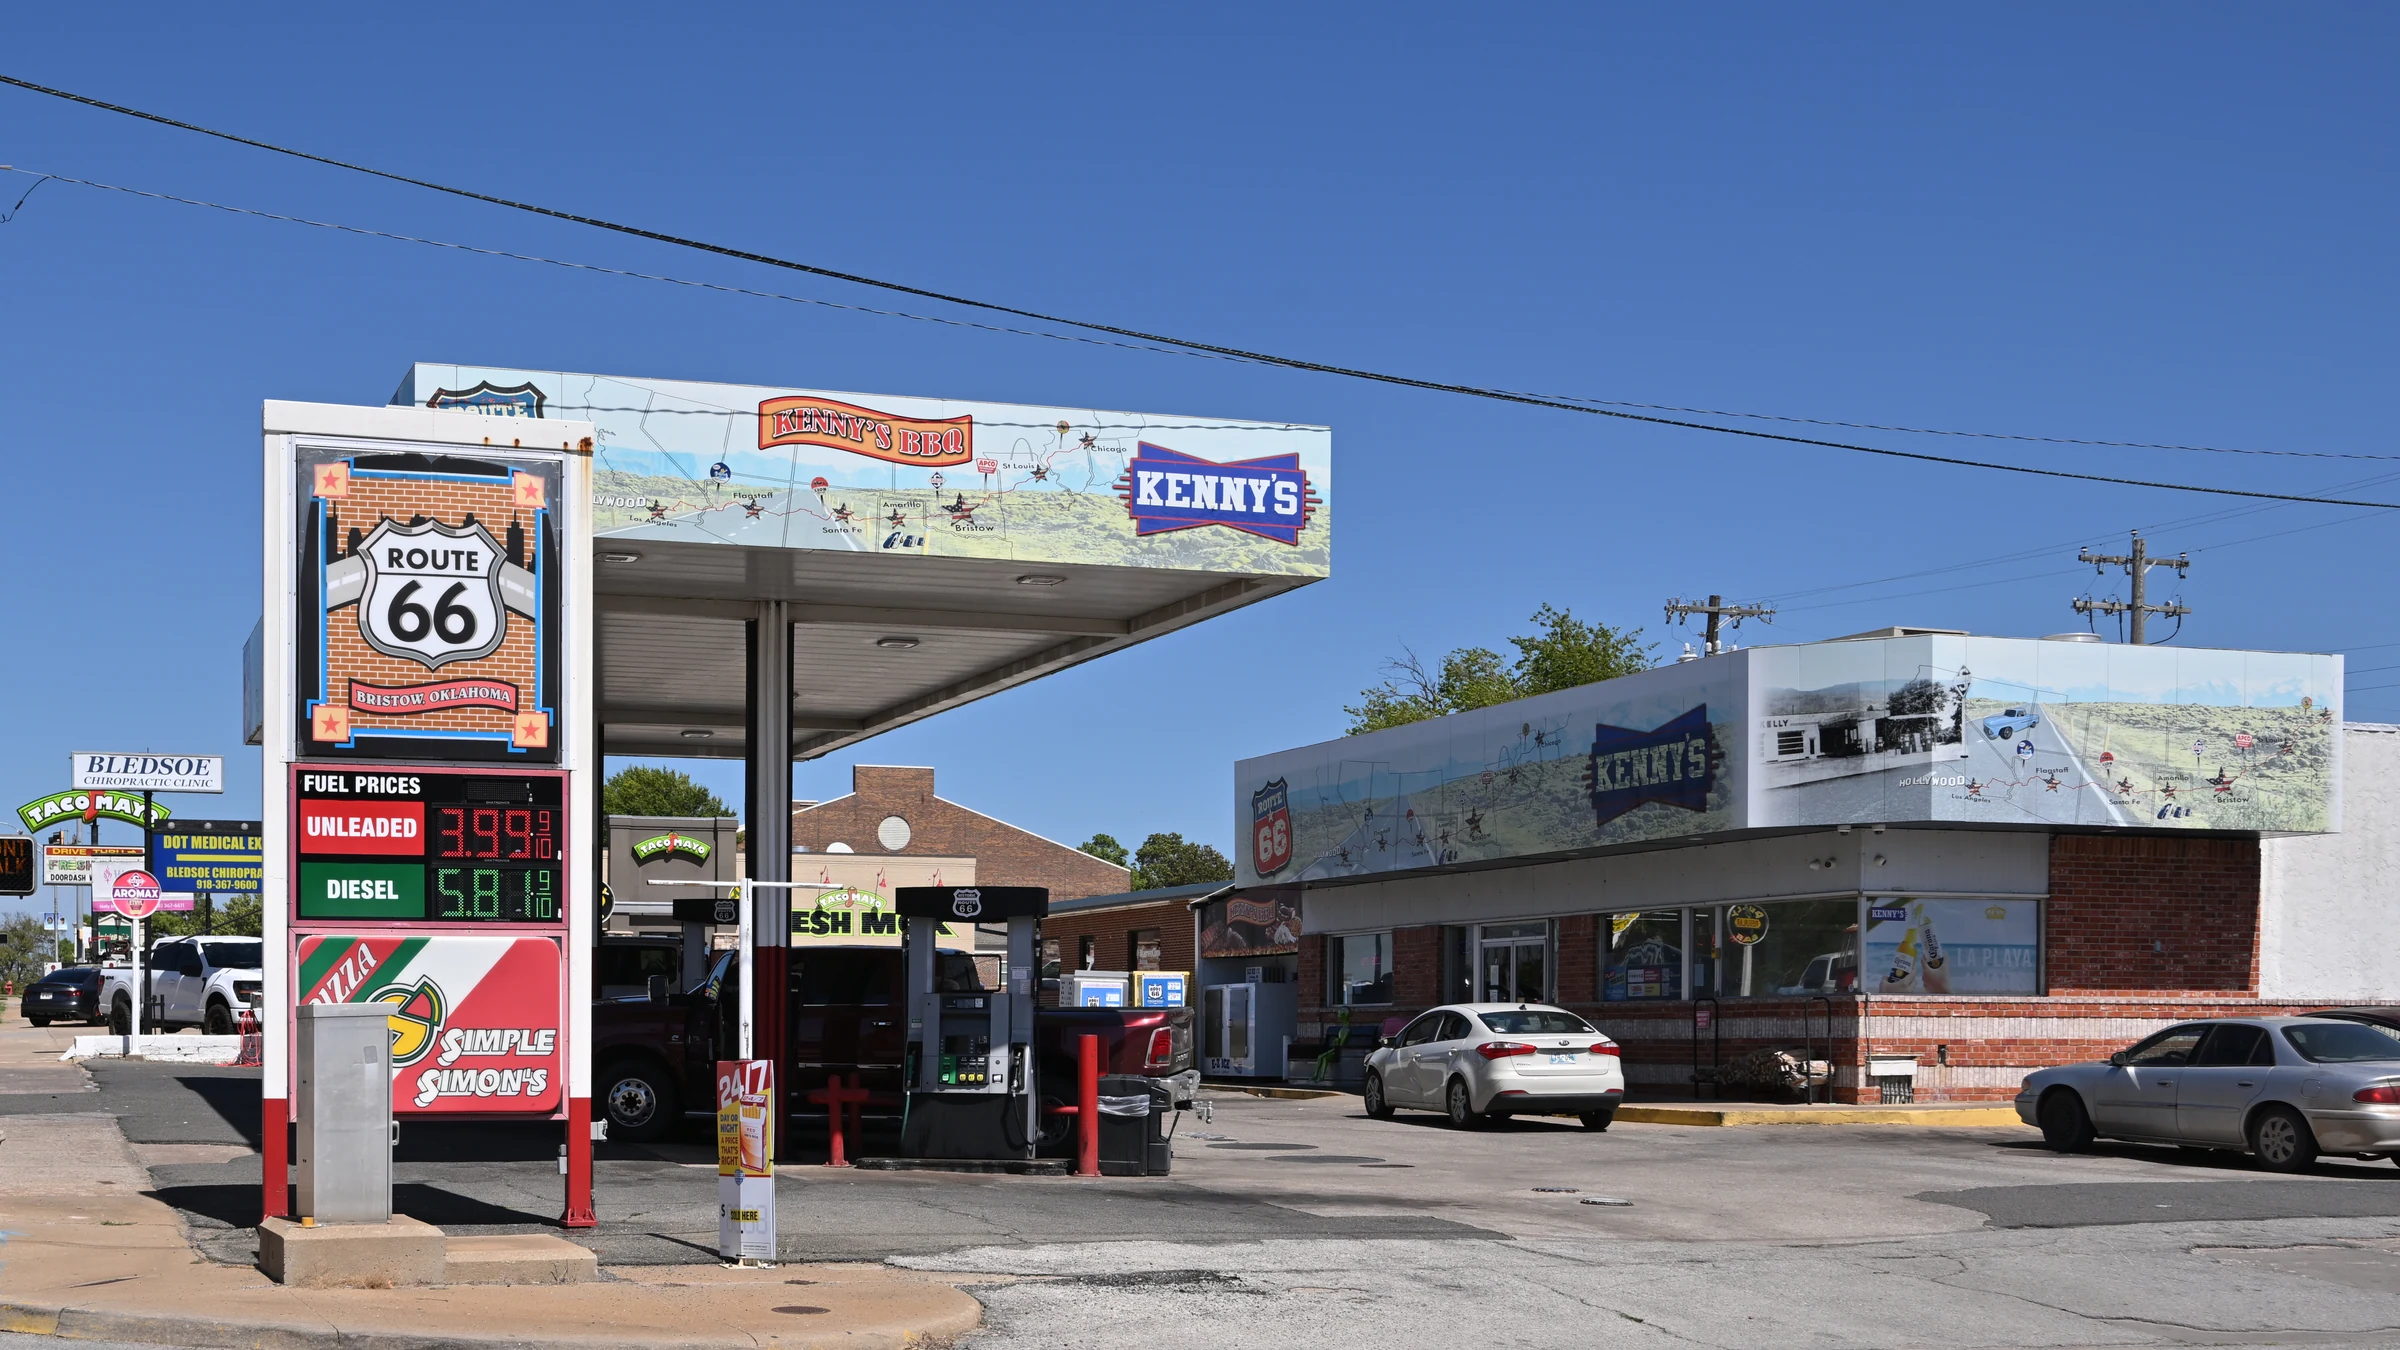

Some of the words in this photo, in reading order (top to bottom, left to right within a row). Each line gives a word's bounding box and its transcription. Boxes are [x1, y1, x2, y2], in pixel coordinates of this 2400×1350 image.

[448, 402, 529, 418] OUTE
[772, 407, 891, 450] KENNY'S
[899, 428, 963, 456] BBQ
[1090, 445, 1128, 454] Chicago
[733, 492, 773, 501] Flagstaff
[1136, 470, 1298, 516] KENNY'S
[645, 518, 678, 528] Angeles
[388, 548, 478, 572] ROUTE
[387, 579, 478, 644] 66
[429, 685, 512, 704] OKLAHOMA
[86, 756, 211, 776] BLEDSOE
[1596, 732, 1706, 792] KENNY'S
[2036, 767, 2069, 775] Flagstaff
[84, 776, 172, 787] CHIROPRACTIC
[174, 778, 213, 788] CLINIC
[304, 774, 349, 793] FUEL
[355, 776, 421, 795] PRICES
[1899, 775, 1965, 788] HOLLYWOOD
[1257, 794, 1283, 815] ROUTE
[1964, 796, 1991, 804] Angeles
[26, 795, 91, 823] TACO
[307, 816, 418, 838] UNLEADED
[442, 808, 531, 859] 3.99
[163, 834, 188, 850] DOT
[191, 836, 246, 850] MEDICAL
[248, 836, 262, 851] EX
[1258, 818, 1288, 863] 66
[1472, 832, 1492, 842] Bristow
[640, 840, 670, 854] TACO
[674, 838, 705, 854] MAYO
[166, 866, 212, 878] BLEDSOE
[114, 888, 158, 898] AROMAX
[196, 880, 258, 890] 918-367-9600
[327, 878, 399, 900] DIESEL
[438, 868, 531, 918] 5.81
[820, 894, 850, 906] TACO
[851, 892, 881, 908] MAYO
[960, 904, 972, 912] 66
[1872, 909, 1904, 918] KENNY'S
[1924, 928, 1938, 958] Corona
[1894, 957, 1912, 968] Corona
[1957, 948, 1976, 967] LA
[1982, 948, 2032, 968] PLAYA
[437, 1028, 556, 1067] SIMPLE
[1222, 1058, 1230, 1069] ICE
[414, 1068, 548, 1108] SIMON'S
[720, 1060, 768, 1110] 24/7
[720, 1114, 730, 1122] DAY
[720, 1124, 738, 1133] NIGHT
[721, 1146, 738, 1154] THAT'S
[721, 1156, 738, 1166] RIGHT
[721, 1204, 725, 1218] $
[731, 1211, 740, 1220] SOLD
[742, 1211, 758, 1220] HERE
